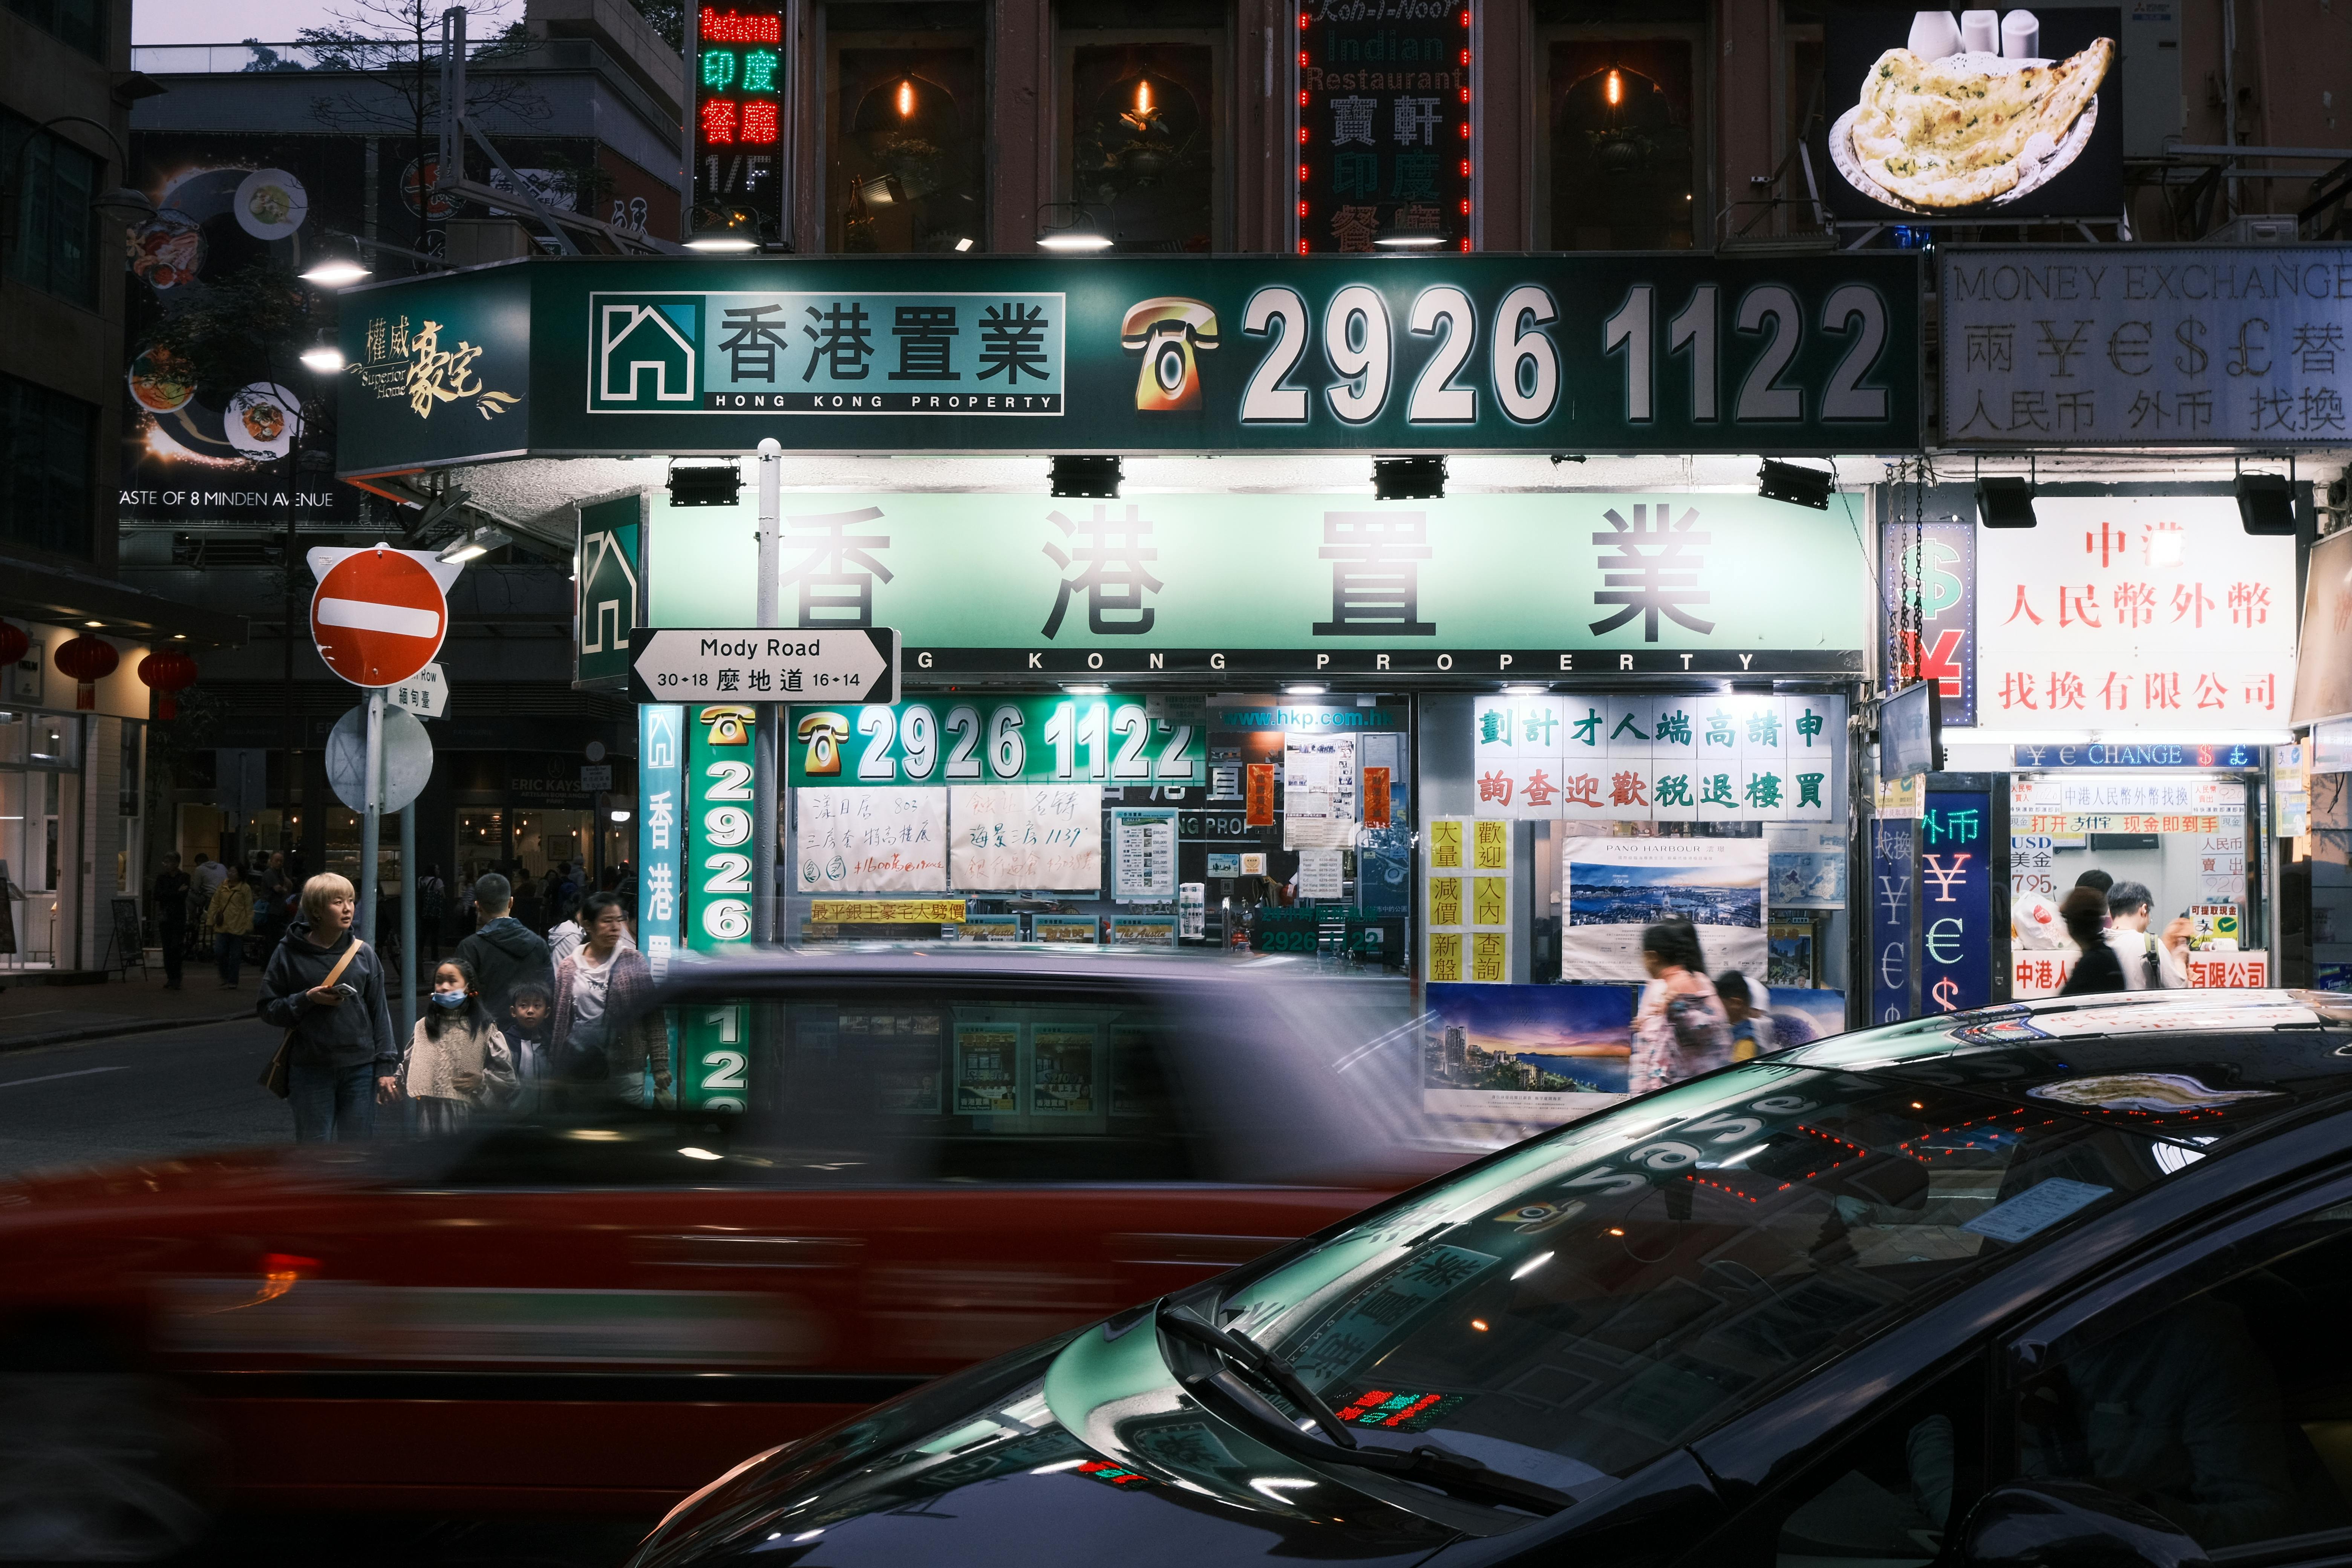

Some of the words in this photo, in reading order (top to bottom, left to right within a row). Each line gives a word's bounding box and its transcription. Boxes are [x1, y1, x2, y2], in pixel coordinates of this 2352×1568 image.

[1327, 30, 1444, 61] Indian
[704, 51, 777, 90] 印度
[1307, 66, 1462, 91] Restaurant
[1330, 95, 1443, 146] 寶軒
[705, 155, 771, 193] 1/F
[1332, 150, 1440, 200] 印度
[1953, 264, 2109, 301] MONEY
[366, 314, 410, 364] 權威
[718, 303, 1050, 384] 香港置業
[1240, 286, 1560, 425] 2926
[1604, 285, 1889, 424] 1122
[361, 366, 407, 390] Superior
[406, 320, 484, 420] 豪宅
[377, 385, 406, 399] Home
[716, 395, 785, 407] HONG
[814, 395, 882, 407] KONG
[912, 395, 1051, 408] PROPERTY
[2249, 387, 2344, 432] 找換
[119, 490, 157, 505] ASTE
[162, 491, 186, 506] OF
[190, 491, 200, 506] 8
[204, 492, 269, 507] MINDEN
[779, 502, 1716, 643] 香港置業
[2000, 581, 2274, 629] 人民幣外幣
[701, 639, 758, 660] Mody
[768, 639, 821, 656] Road
[1028, 653, 1226, 670] KONG
[1315, 653, 1753, 671] PROPERTY
[421, 669, 437, 683] Row
[657, 673, 678, 687] 30
[692, 673, 709, 687] 18
[716, 668, 804, 692] 麼地道
[813, 673, 829, 687] 16
[844, 673, 860, 687] 14
[1998, 671, 2277, 711] 找換有限公司
[1224, 710, 1393, 729] www.hkp.com.hk
[856, 704, 1027, 780] 2926
[1045, 704, 1195, 780] 1122
[2088, 744, 2182, 765] CHANGE
[2198, 743, 2213, 766] $
[2230, 743, 2248, 766] £
[511, 778, 543, 791] ERIC
[545, 779, 582, 793] KAYS
[2065, 786, 2188, 806] 中港人民幣外幣找換
[2195, 785, 2217, 793] 人民幣
[2219, 787, 2243, 801] 920
[2011, 817, 2028, 826] 現金
[2031, 815, 2067, 833] 打开
[2124, 815, 2219, 833] 现金即到手
[2222, 817, 2241, 827] 現金
[704, 760, 754, 939] 2926
[2011, 836, 2052, 848] USD
[2011, 851, 2052, 868] 美金
[2012, 874, 2052, 894] 795
[2205, 876, 2244, 894] 920
[2191, 905, 2237, 916] 可提取現金
[1117, 927, 1134, 939] The
[1135, 928, 1166, 938] Austin
[1261, 930, 1318, 951] 2926
[2326, 979, 2347, 989] Tempo
